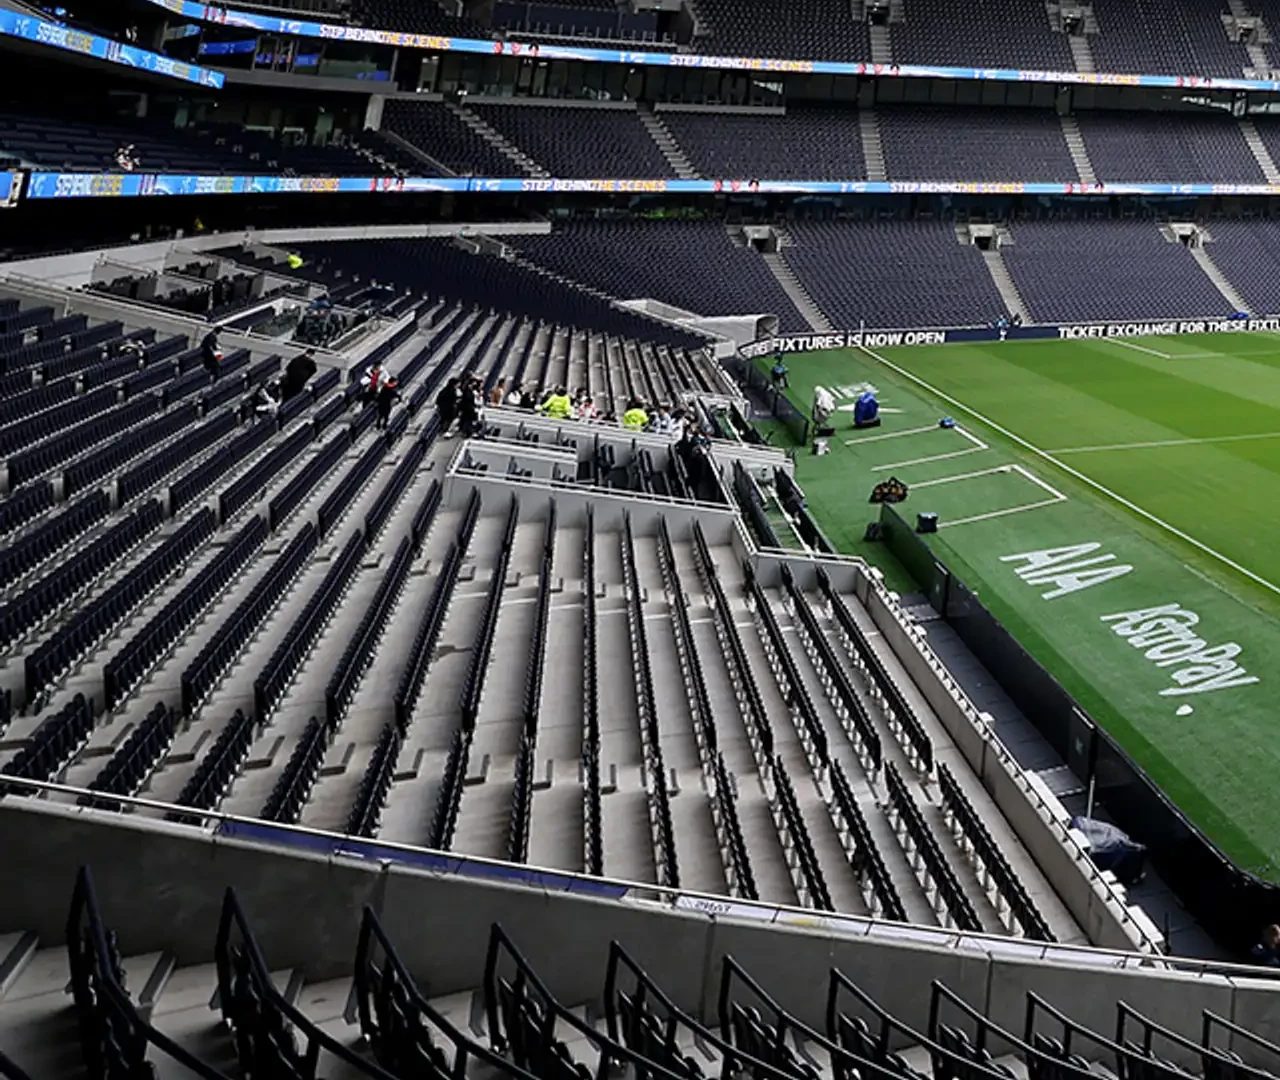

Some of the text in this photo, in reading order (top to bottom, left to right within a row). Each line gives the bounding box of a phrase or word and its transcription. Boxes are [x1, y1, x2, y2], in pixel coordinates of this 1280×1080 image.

[1058, 326, 1105, 339] TICKET
[1108, 324, 1177, 337] EXCHANGE
[1180, 322, 1206, 333] FOR
[1208, 320, 1246, 332] THESE
[772, 335, 844, 352] FIXTURES
[847, 334, 862, 347] IS
[865, 333, 903, 346] NOW
[905, 332, 945, 345] OPEN
[999, 542, 1134, 600] AIA
